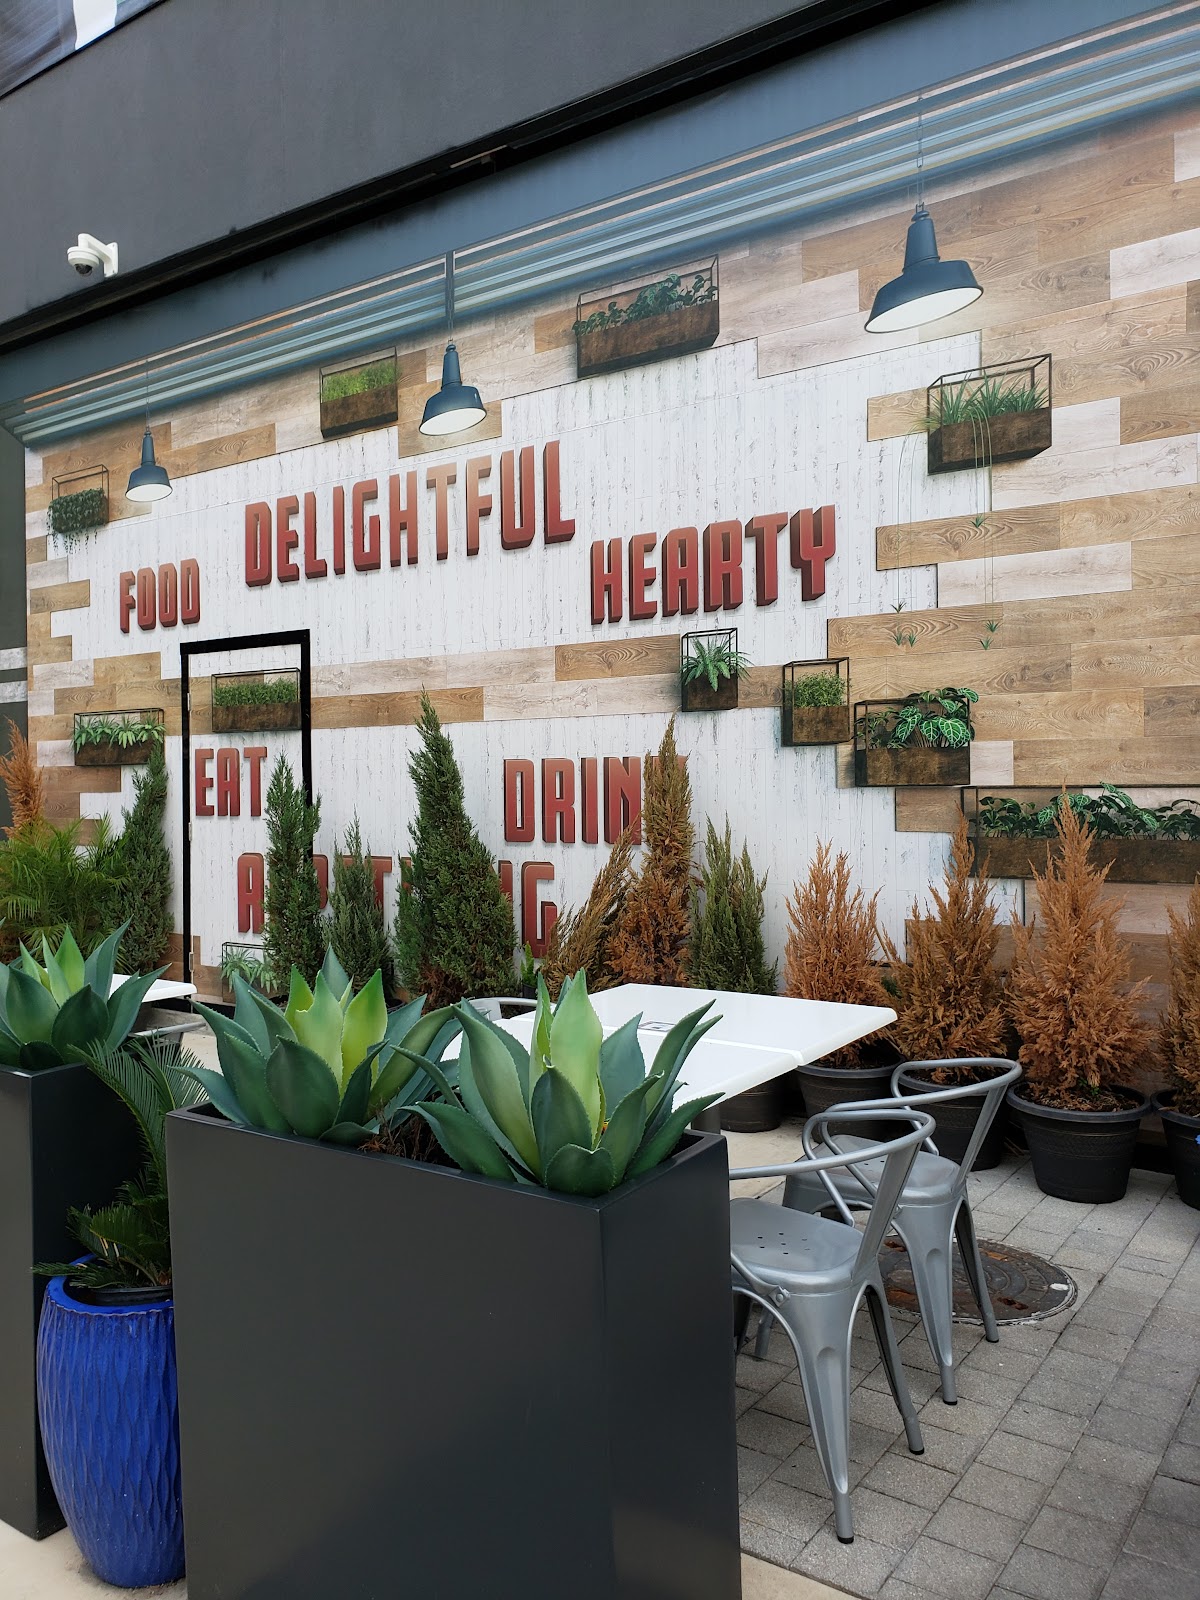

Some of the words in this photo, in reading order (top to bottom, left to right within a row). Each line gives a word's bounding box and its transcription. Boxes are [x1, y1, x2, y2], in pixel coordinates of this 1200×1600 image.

[244, 440, 576, 587] DELIGHTFUL
[119, 557, 200, 634] FOOD
[590, 504, 836, 625] HEARTY
[195, 746, 268, 816] EAT
[503, 755, 690, 845] DRIN
